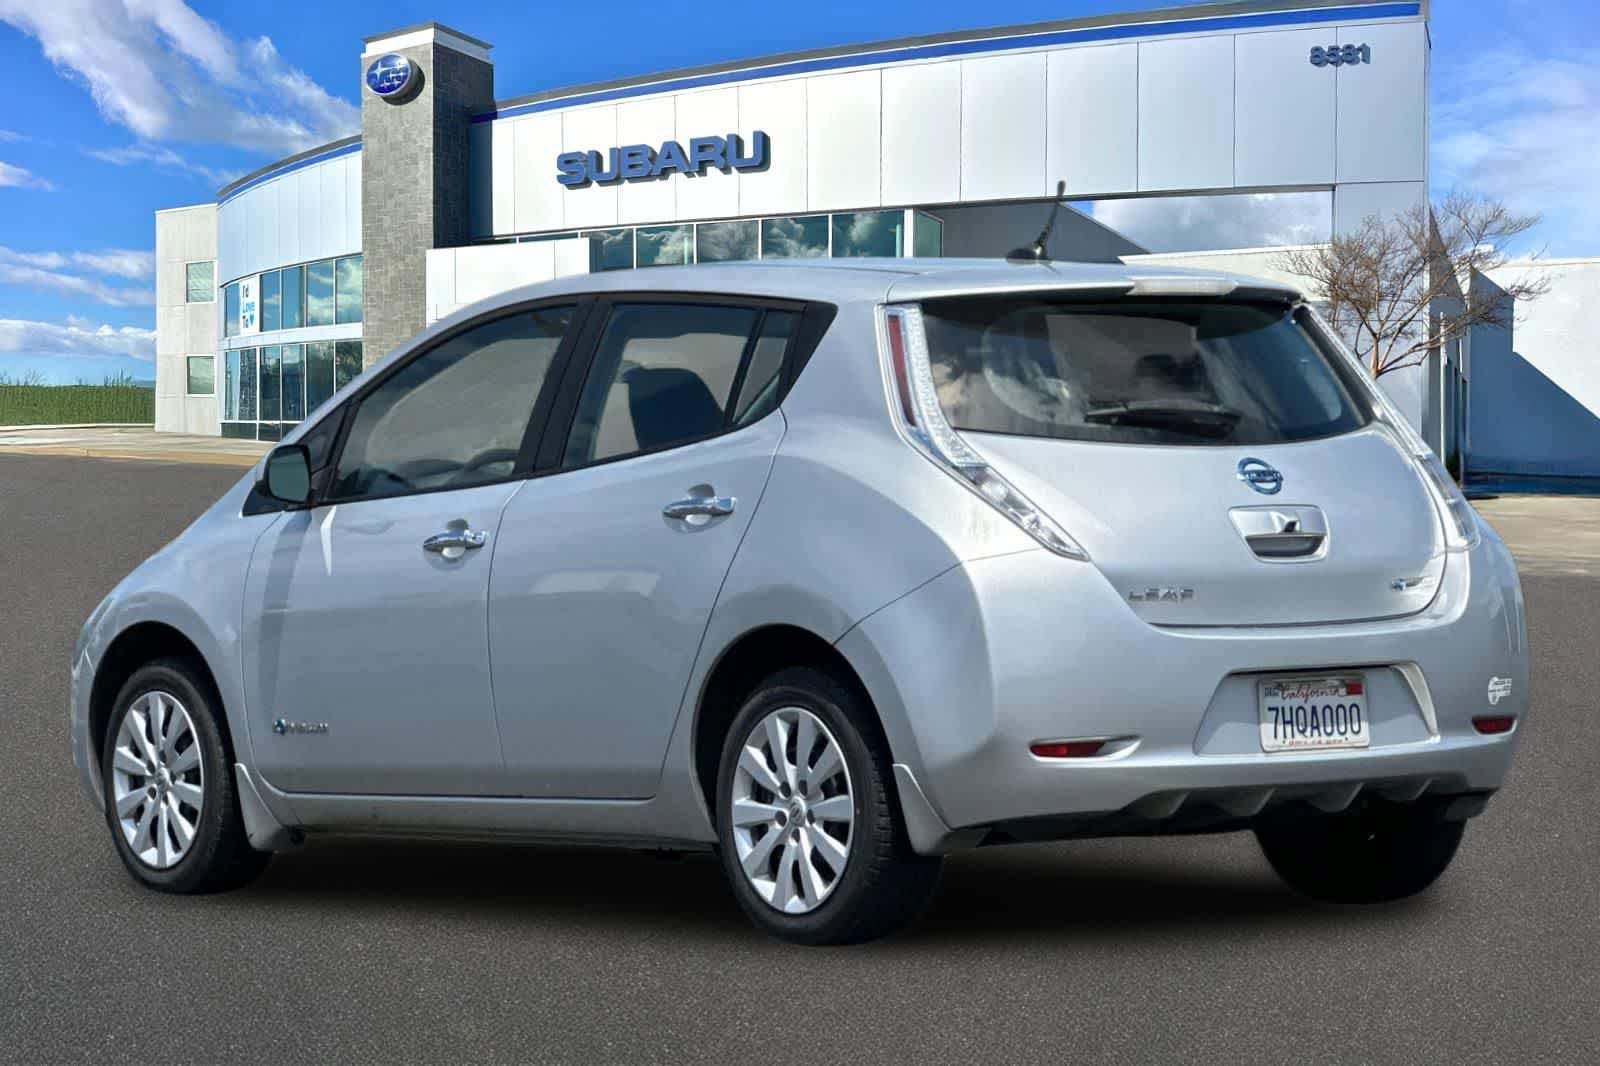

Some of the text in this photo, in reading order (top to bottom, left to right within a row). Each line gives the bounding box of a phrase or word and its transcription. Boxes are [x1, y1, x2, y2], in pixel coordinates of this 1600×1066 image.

[557, 130, 770, 189] SUBARU
[1128, 588, 1193, 602] LEAF
[1280, 683, 1344, 703] California
[1267, 703, 1361, 740] 7HQA000
